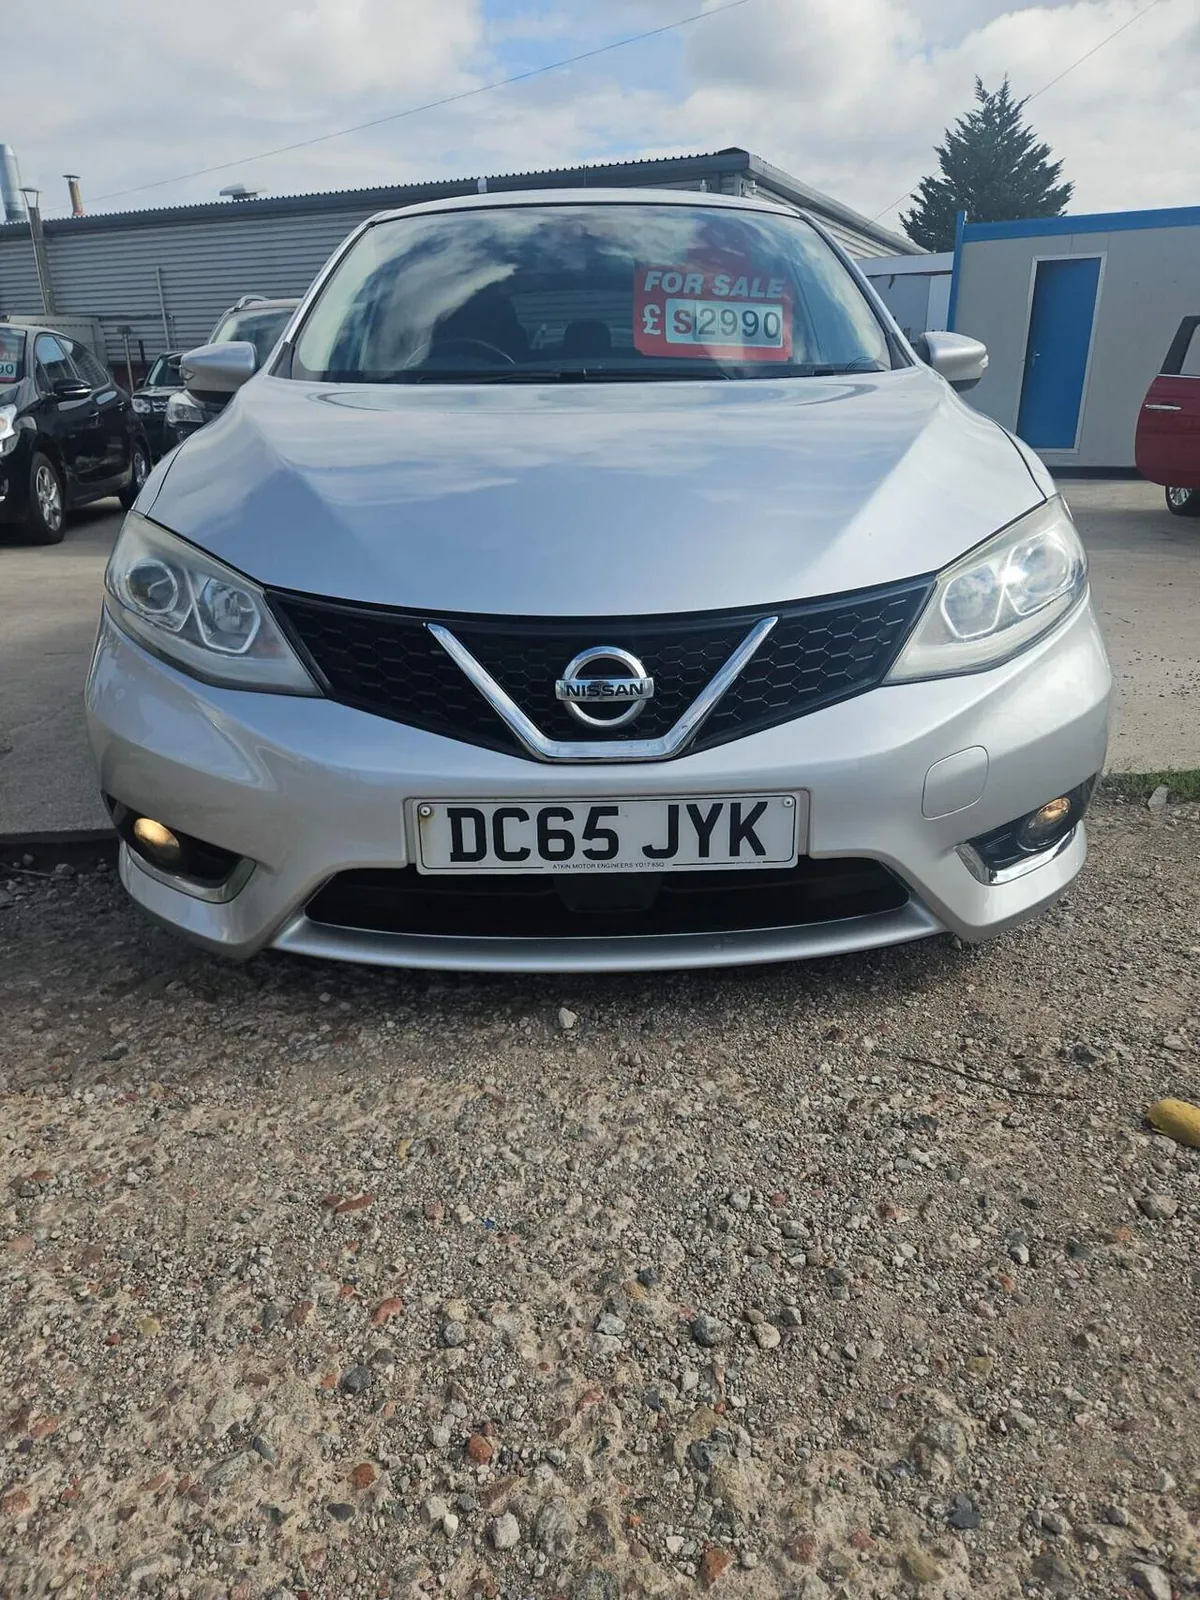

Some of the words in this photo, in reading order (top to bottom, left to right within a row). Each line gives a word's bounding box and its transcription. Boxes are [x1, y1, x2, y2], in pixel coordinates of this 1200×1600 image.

[644, 271, 705, 294] FOR
[711, 274, 787, 298] SALE
[566, 683, 644, 697] NISSAN
[446, 806, 620, 863] DC65
[641, 801, 769, 859] JYK
